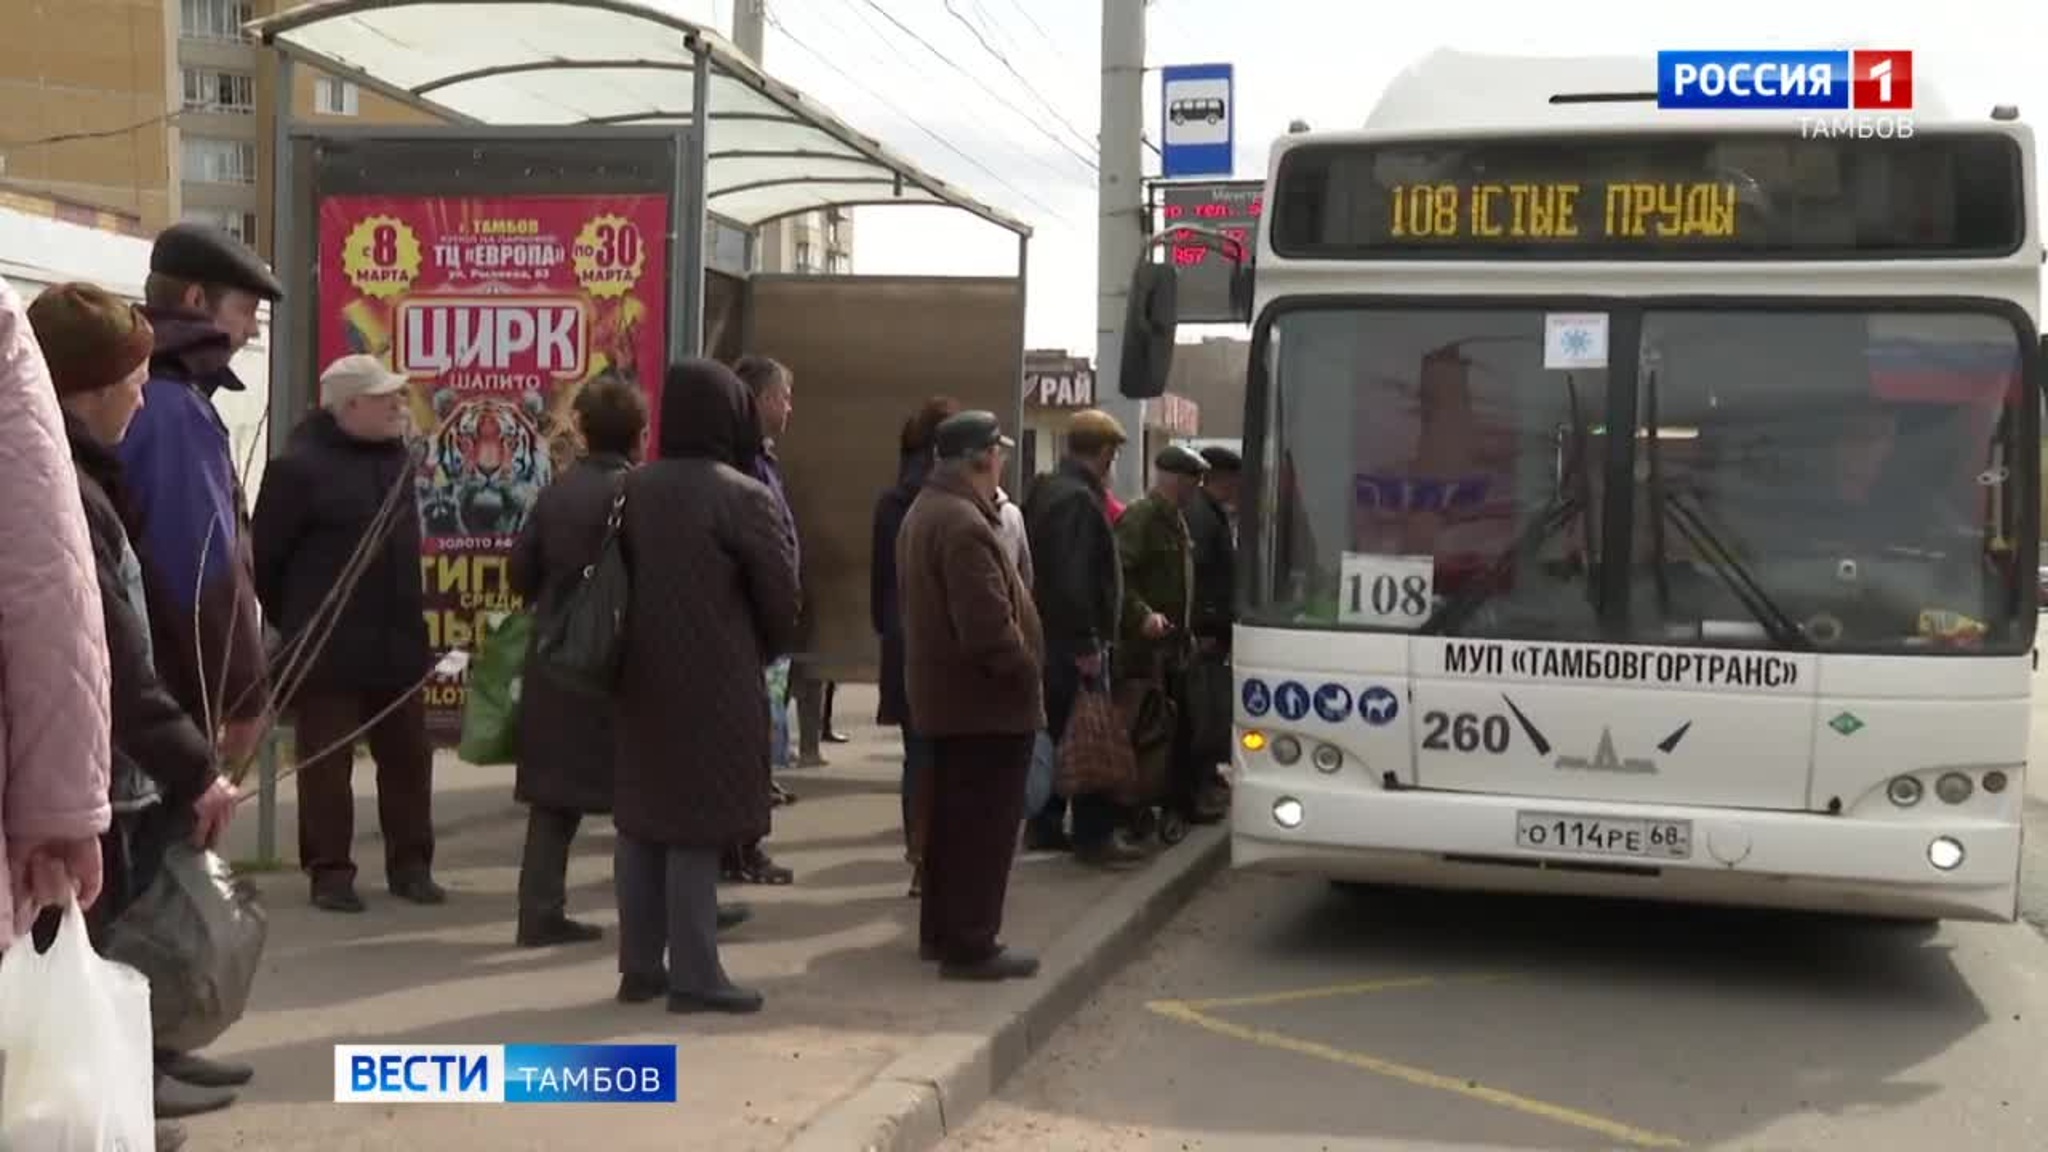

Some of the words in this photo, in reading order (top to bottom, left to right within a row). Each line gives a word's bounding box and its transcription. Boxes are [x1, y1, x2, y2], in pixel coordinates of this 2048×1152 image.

[473, 219, 539, 234] ТАМБОВ
[1390, 184, 1458, 237] 108
[1471, 184, 1579, 236] СТЫЕ
[1605, 184, 1736, 236] ПРУДЫ
[374, 224, 398, 267] 8
[434, 244, 460, 269] ТЦ
[464, 244, 565, 267] «ЕВРОПА»
[597, 223, 640, 268] 30
[356, 269, 409, 283] МАРТА
[581, 270, 636, 283] МАРТА
[406, 306, 579, 376] ЦИРК
[450, 372, 541, 391] ШАПИТО
[1040, 370, 1092, 406] РАЙ
[438, 538, 492, 549] ЗОЛОТО
[1346, 573, 1429, 617] 108
[1444, 643, 1502, 674] МУП
[1511, 646, 1798, 687] «ТАМБОВГОРТРАНС»
[1422, 711, 1511, 754] 260
[1650, 825, 1679, 846] 68
